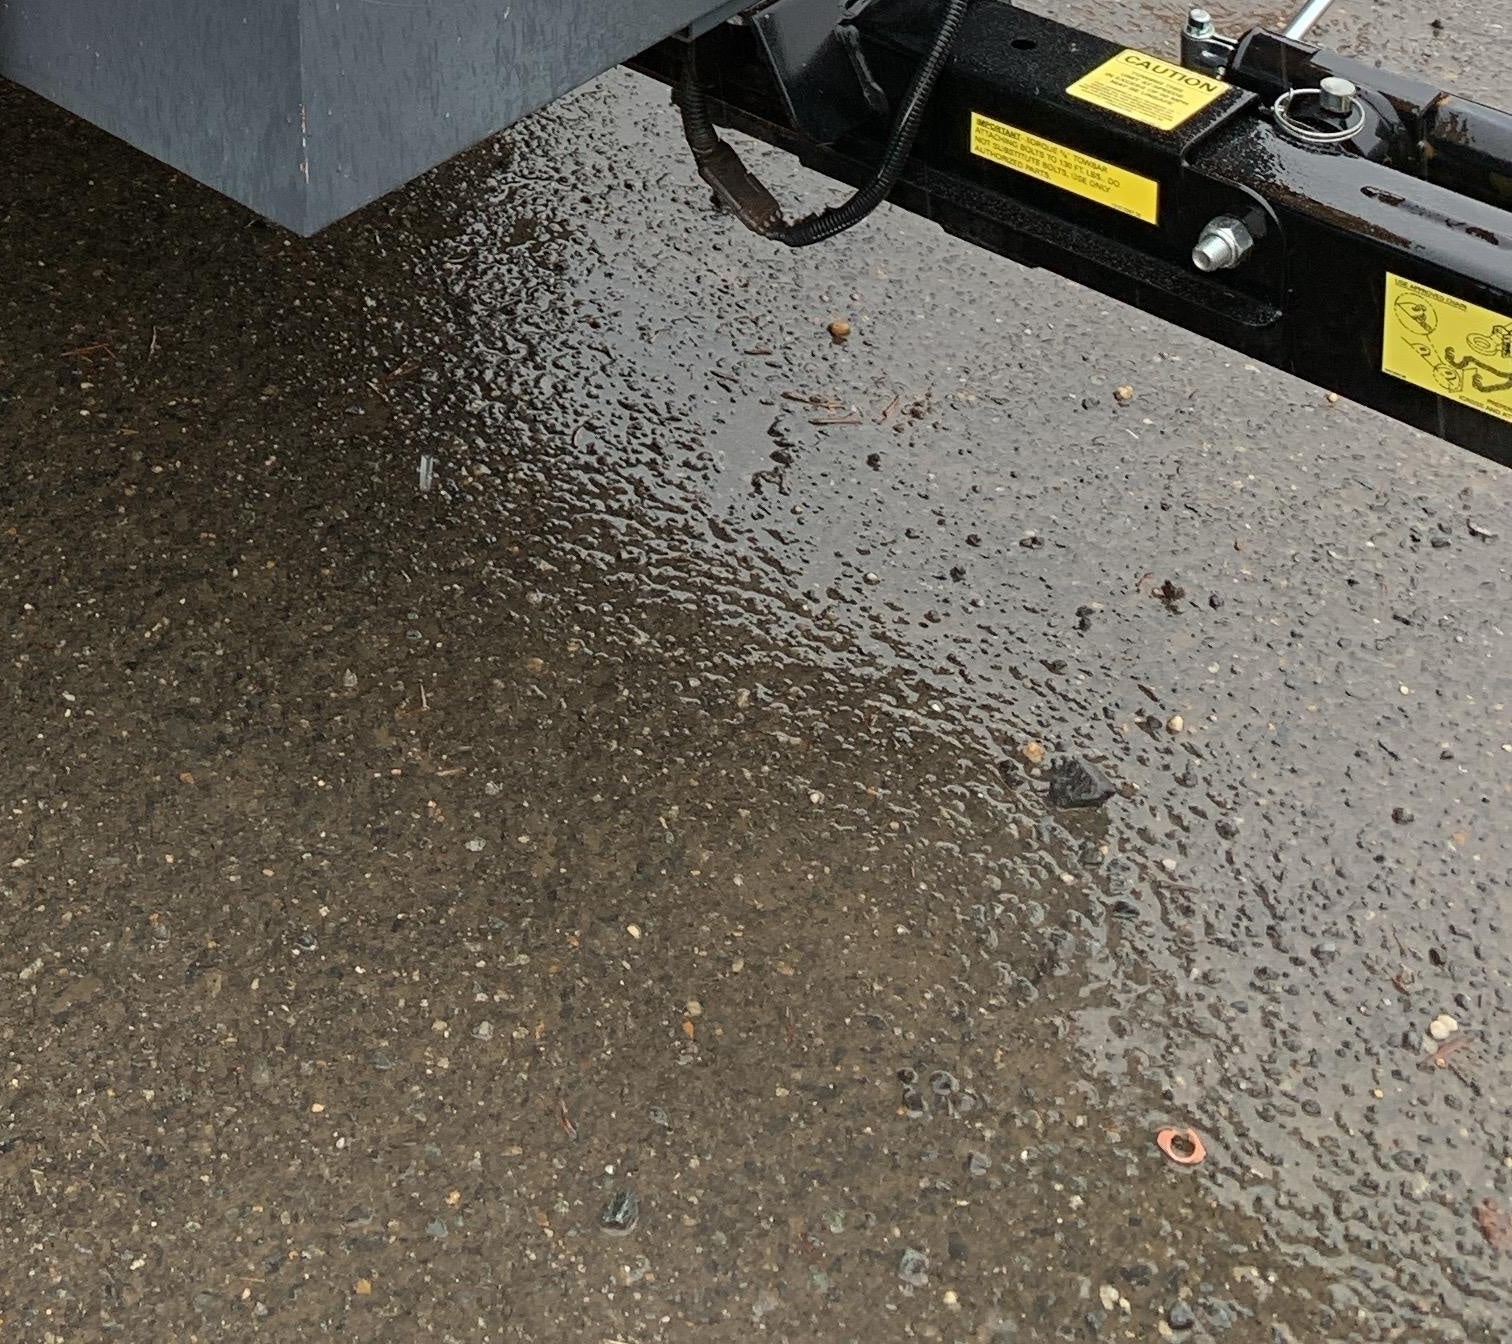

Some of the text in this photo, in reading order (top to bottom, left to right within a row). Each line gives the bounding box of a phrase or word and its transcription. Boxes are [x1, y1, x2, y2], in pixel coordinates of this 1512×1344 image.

[1125, 55, 1218, 93] CAUTION
[975, 126, 1019, 148] ATTACHING
[1020, 143, 1045, 159] BOLTS
[1046, 153, 1057, 164] TO
[1107, 176, 1121, 188] DO
[975, 136, 991, 146] NOT
[1089, 179, 1112, 193] ONLY
